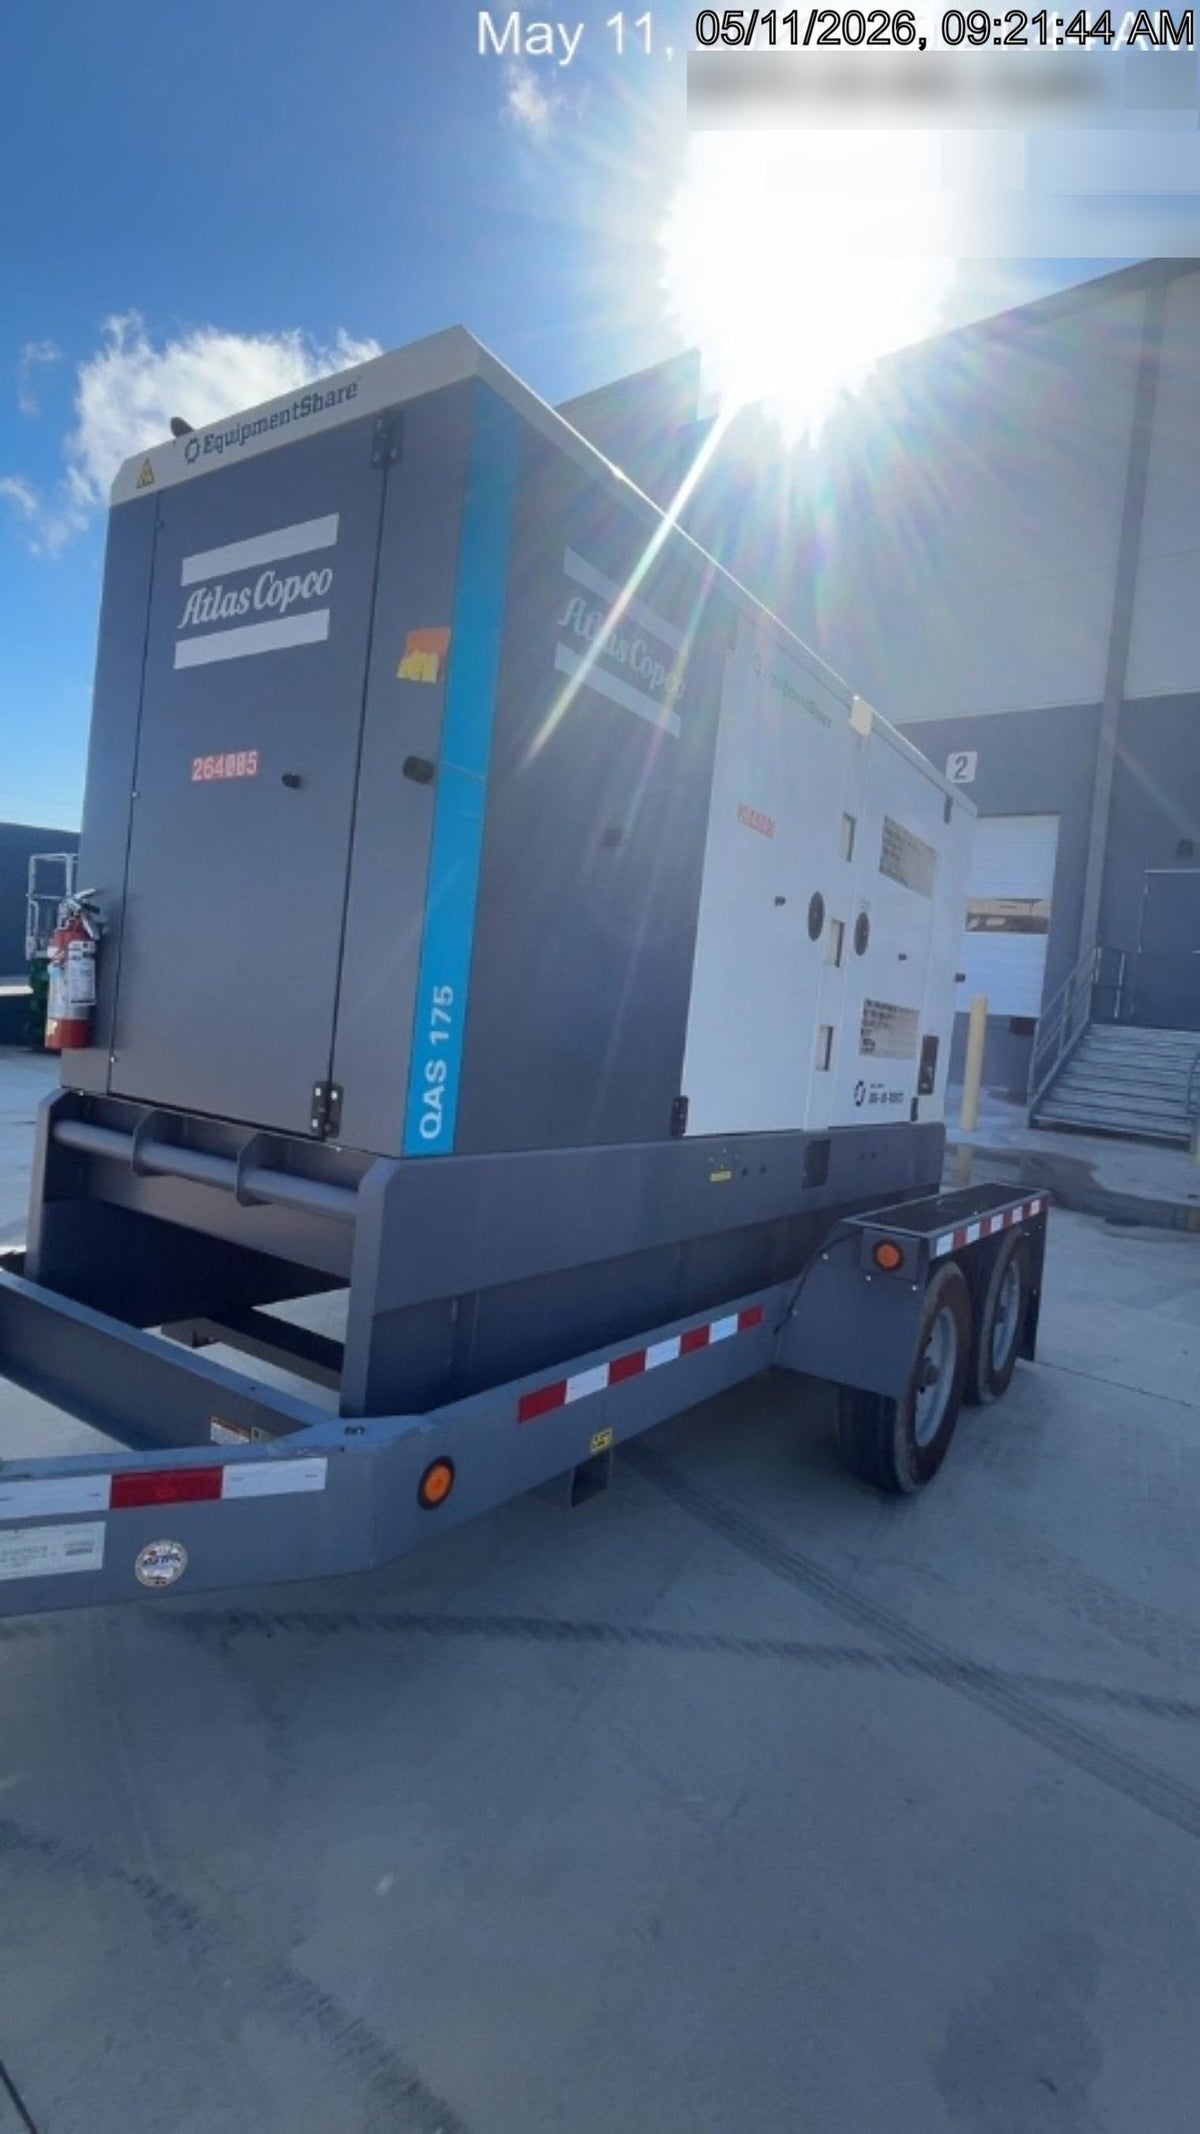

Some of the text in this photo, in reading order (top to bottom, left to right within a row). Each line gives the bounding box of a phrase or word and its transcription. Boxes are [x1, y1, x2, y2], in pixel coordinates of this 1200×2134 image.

[203, 382, 358, 455] EquipmentShare
[177, 568, 333, 629] Atlas Copco
[953, 755, 969, 780] 2
[419, 985, 454, 1140] QAS 175
